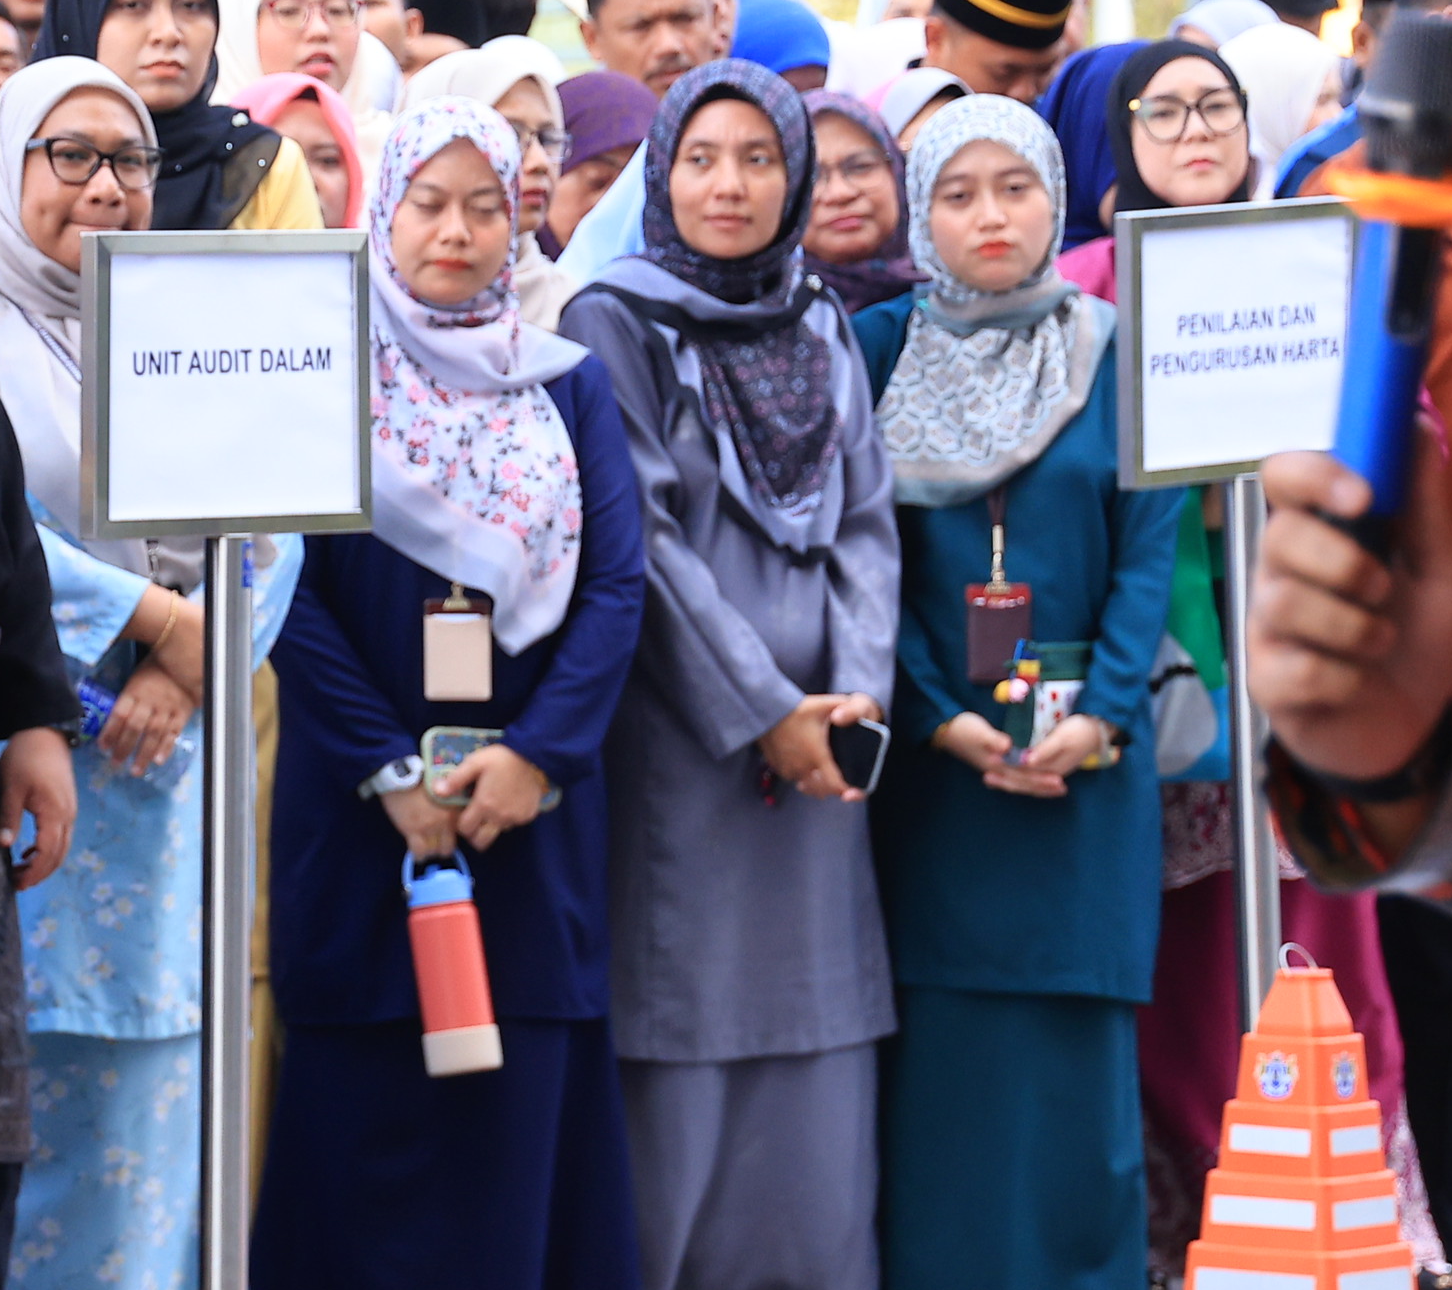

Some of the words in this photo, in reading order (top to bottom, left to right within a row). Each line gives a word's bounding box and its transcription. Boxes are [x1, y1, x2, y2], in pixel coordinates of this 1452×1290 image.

[1177, 308, 1274, 337] PENILAIAN
[1280, 303, 1317, 329] DAN
[133, 350, 182, 376] UNIT
[188, 349, 252, 374] AUDIT
[260, 347, 332, 373] DALAM
[1151, 342, 1278, 377] PENGURUSAN
[1282, 336, 1340, 363] HARTA
